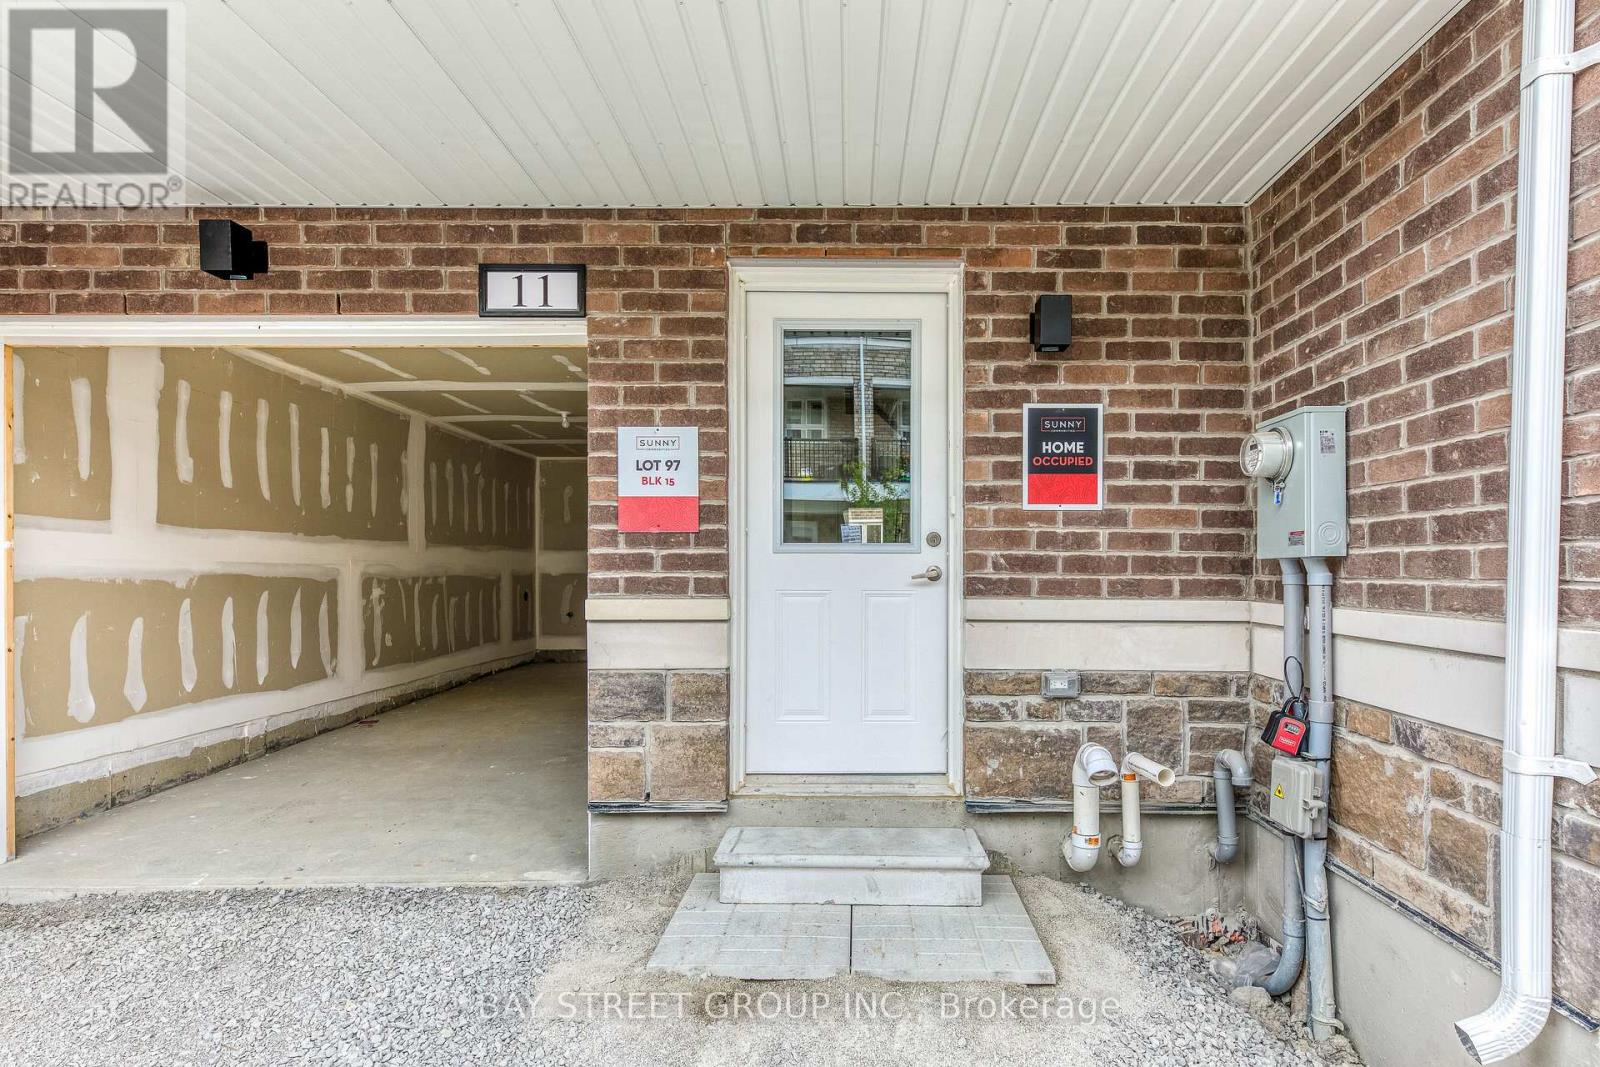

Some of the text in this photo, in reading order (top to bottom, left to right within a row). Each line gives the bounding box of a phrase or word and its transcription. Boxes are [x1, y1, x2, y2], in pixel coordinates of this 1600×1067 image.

[512, 274, 553, 307] 11
[1044, 420, 1082, 428] SUNNY
[1042, 441, 1085, 454] HOME
[636, 460, 680, 471] LOT 97
[1032, 456, 1094, 466] OCCUPIED
[641, 476, 675, 487] BLK 15
